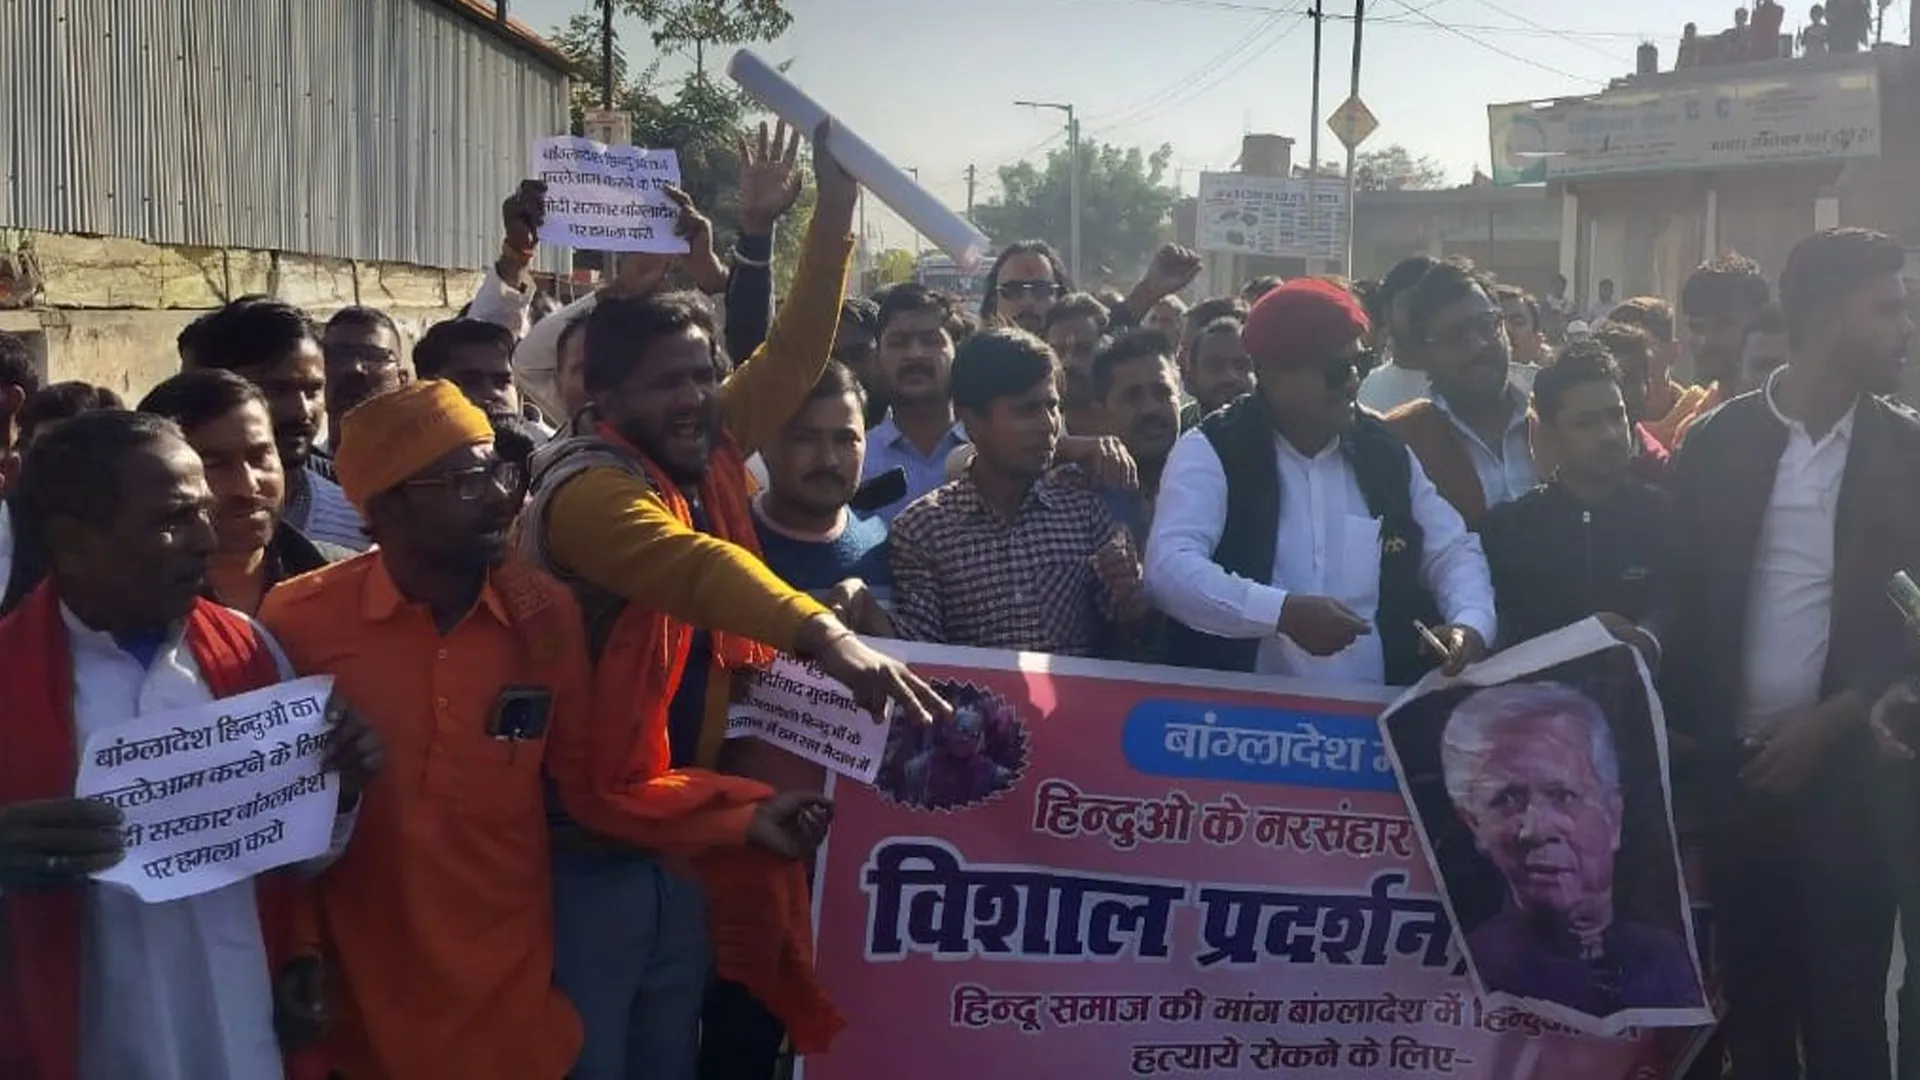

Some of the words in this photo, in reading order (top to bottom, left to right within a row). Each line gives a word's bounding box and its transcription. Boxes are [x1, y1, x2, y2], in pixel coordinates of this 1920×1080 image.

[95, 726, 212, 769] बांग्लादेश
[291, 696, 322, 717] का
[209, 750, 266, 785] करने
[270, 741, 293, 767] के
[1165, 712, 1365, 773] बांग्लादेश
[150, 808, 234, 844] सरकार
[236, 772, 327, 821] बांग्लादेश
[1034, 780, 1193, 848] हिन्दुओ
[1203, 795, 1248, 845] के
[1256, 801, 1413, 858] नरसंहार
[143, 856, 173, 880] पर
[176, 837, 241, 874] हमला
[245, 819, 285, 851] करो
[867, 843, 1185, 957] विशाल
[953, 985, 1042, 1031] हिन्दू
[1049, 994, 1152, 1025] समाज
[1159, 987, 1204, 1022] की
[1212, 991, 1283, 1024] मांग
[1287, 990, 1425, 1026] बांग्लादेश
[1434, 990, 1461, 1026] में
[1131, 1036, 1243, 1075] हत्याये
[1250, 1037, 1342, 1070] रोकने
[1347, 1035, 1381, 1068] के
